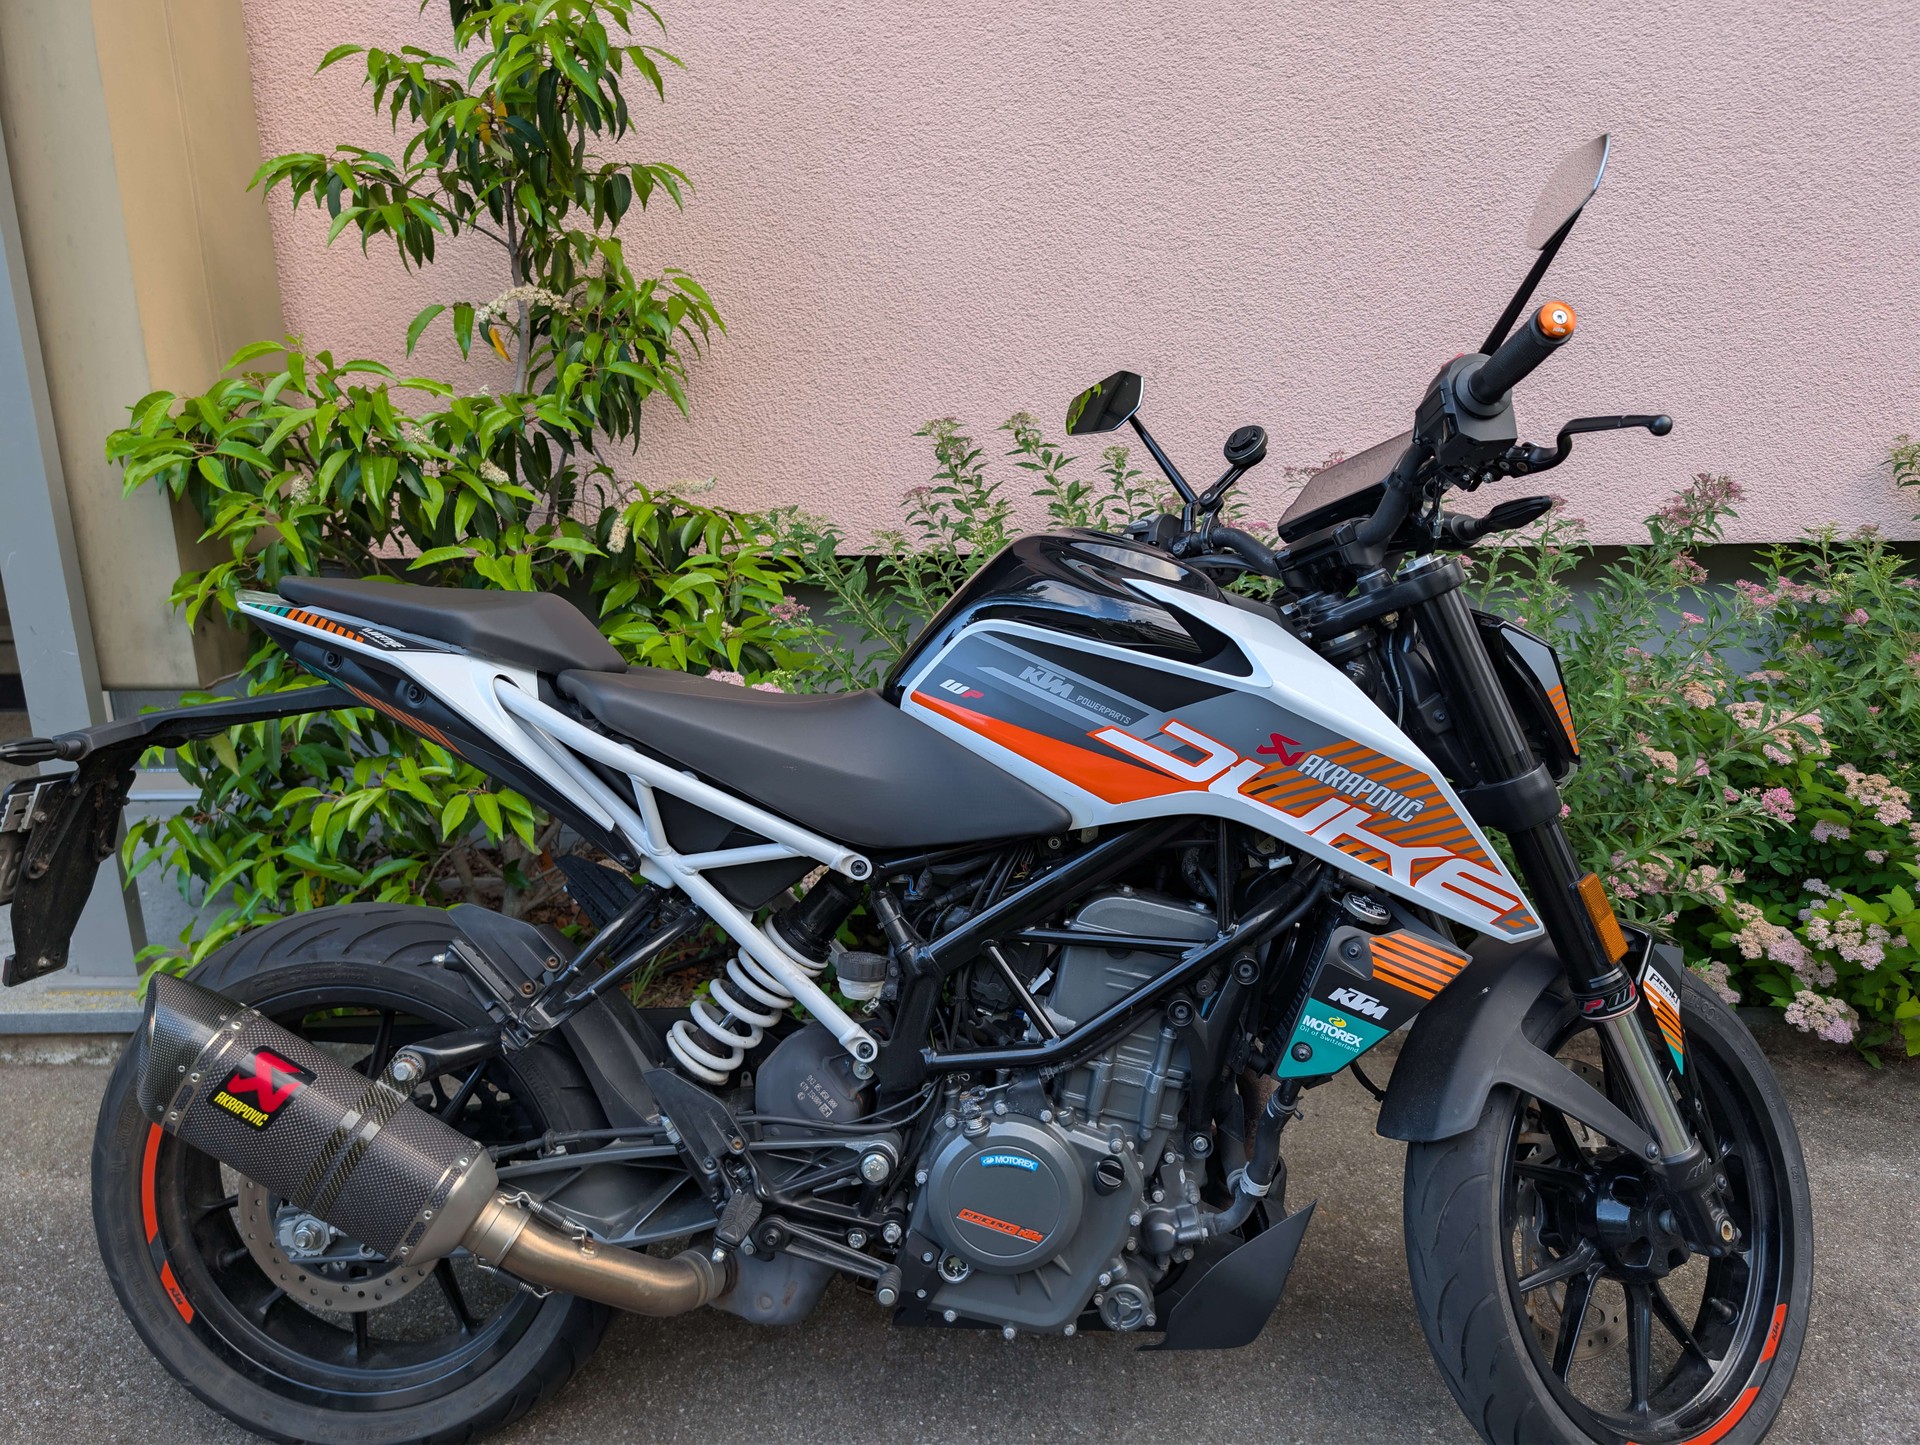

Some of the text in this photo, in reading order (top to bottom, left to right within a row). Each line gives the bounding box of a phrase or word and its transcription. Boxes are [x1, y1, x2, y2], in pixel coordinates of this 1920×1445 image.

[939, 679, 984, 699] WP
[1018, 666, 1131, 724] KTM POWERPARTS
[1089, 720, 1520, 922] DUKE
[1328, 987, 1389, 1020] KTM
[1300, 1025, 1310, 1033] Oil
[1320, 1033, 1360, 1054] Switzerland
[1302, 1014, 1363, 1048] MOTOREX
[995, 1156, 1035, 1169] MOTOREX
[963, 1211, 1015, 1232] RACING
